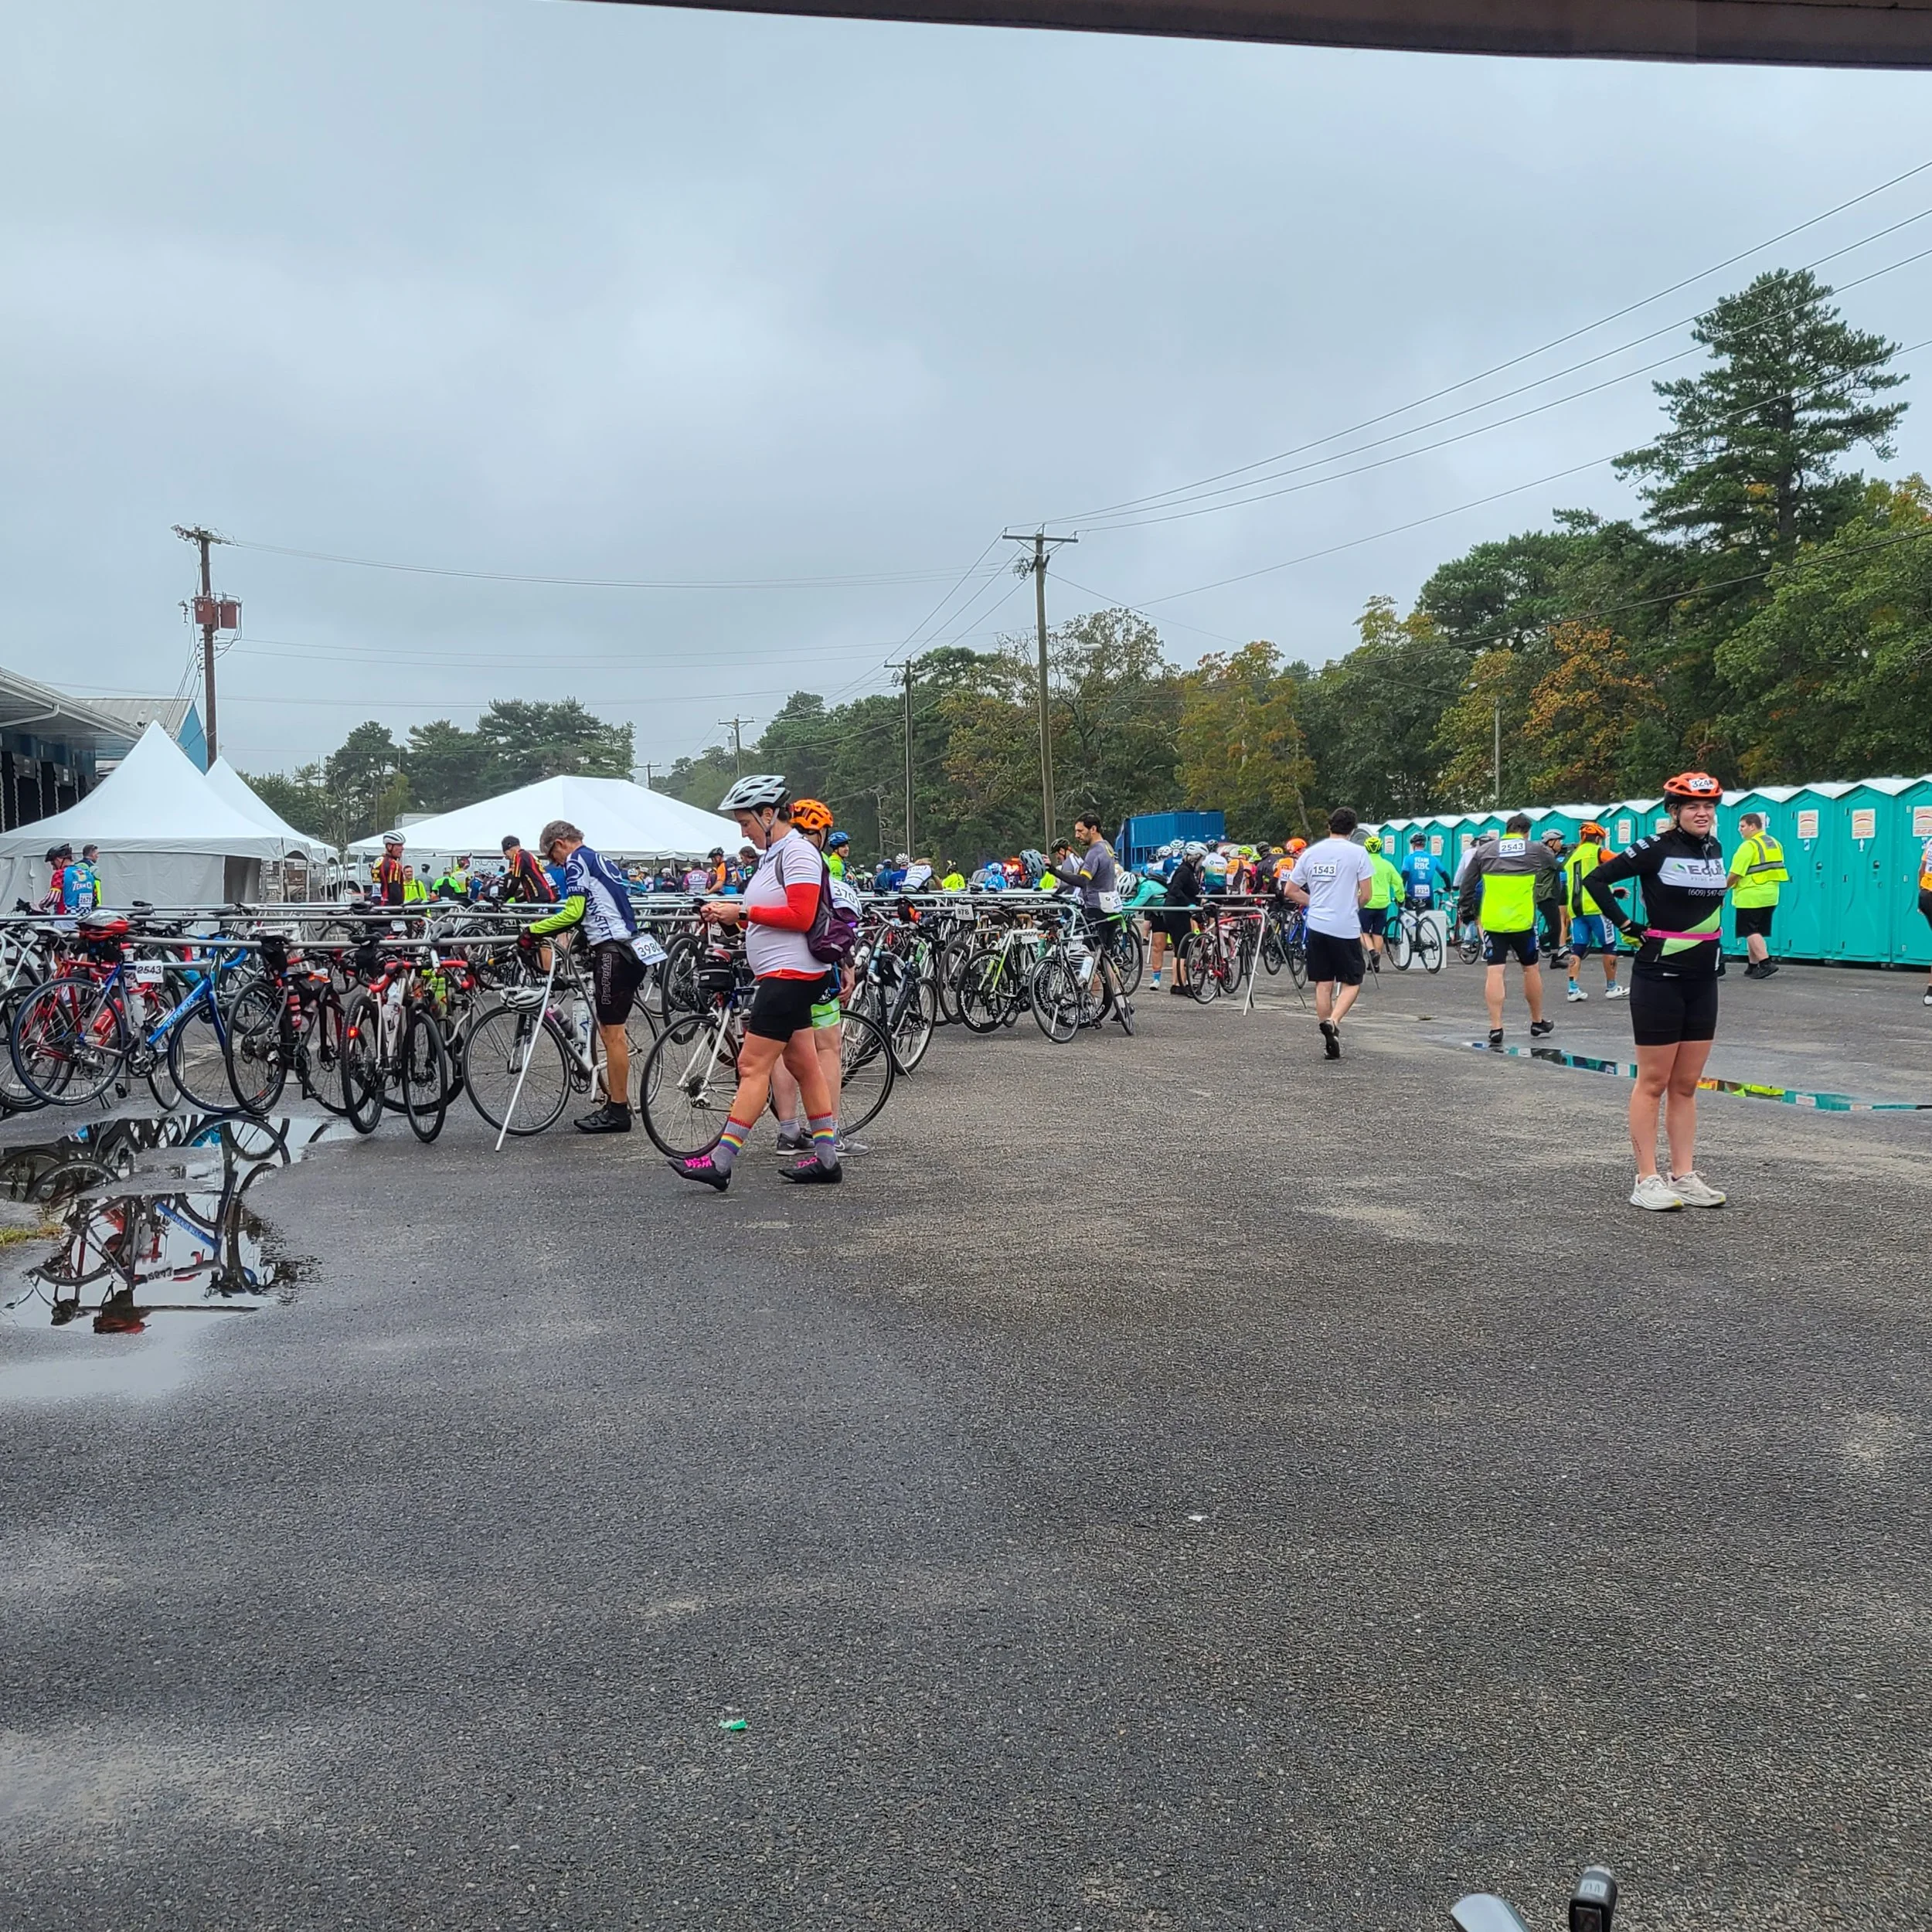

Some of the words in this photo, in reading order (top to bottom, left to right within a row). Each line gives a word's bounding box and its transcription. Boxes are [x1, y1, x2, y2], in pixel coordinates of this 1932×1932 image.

[1501, 842, 1524, 851] 2543
[1314, 866, 1335, 874] 1543
[137, 965, 162, 975] 2543
